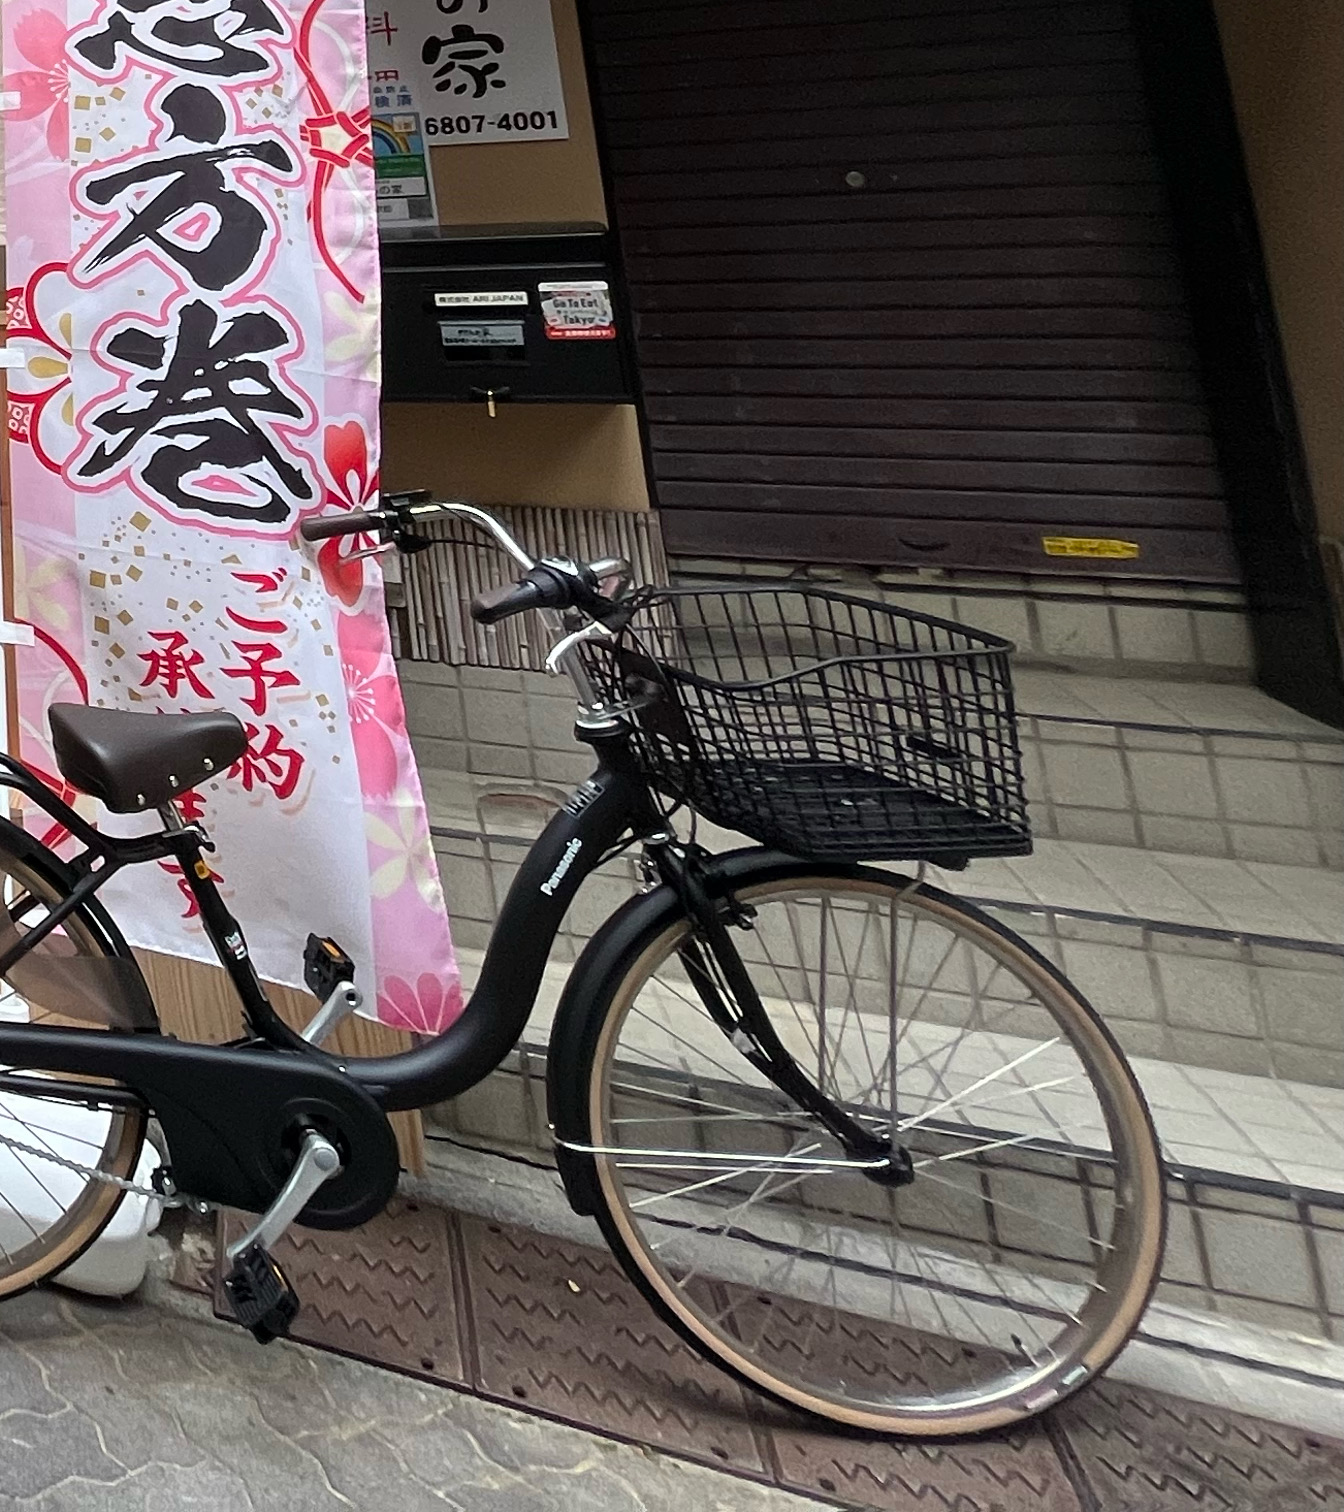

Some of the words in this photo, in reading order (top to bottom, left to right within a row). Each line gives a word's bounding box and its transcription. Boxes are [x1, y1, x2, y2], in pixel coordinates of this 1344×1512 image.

[424, 110, 558, 136] 6807-4001
[491, 293, 524, 303] JAPAN
[219, 568, 304, 800] ご予約
[540, 837, 582, 896] Panasonic
